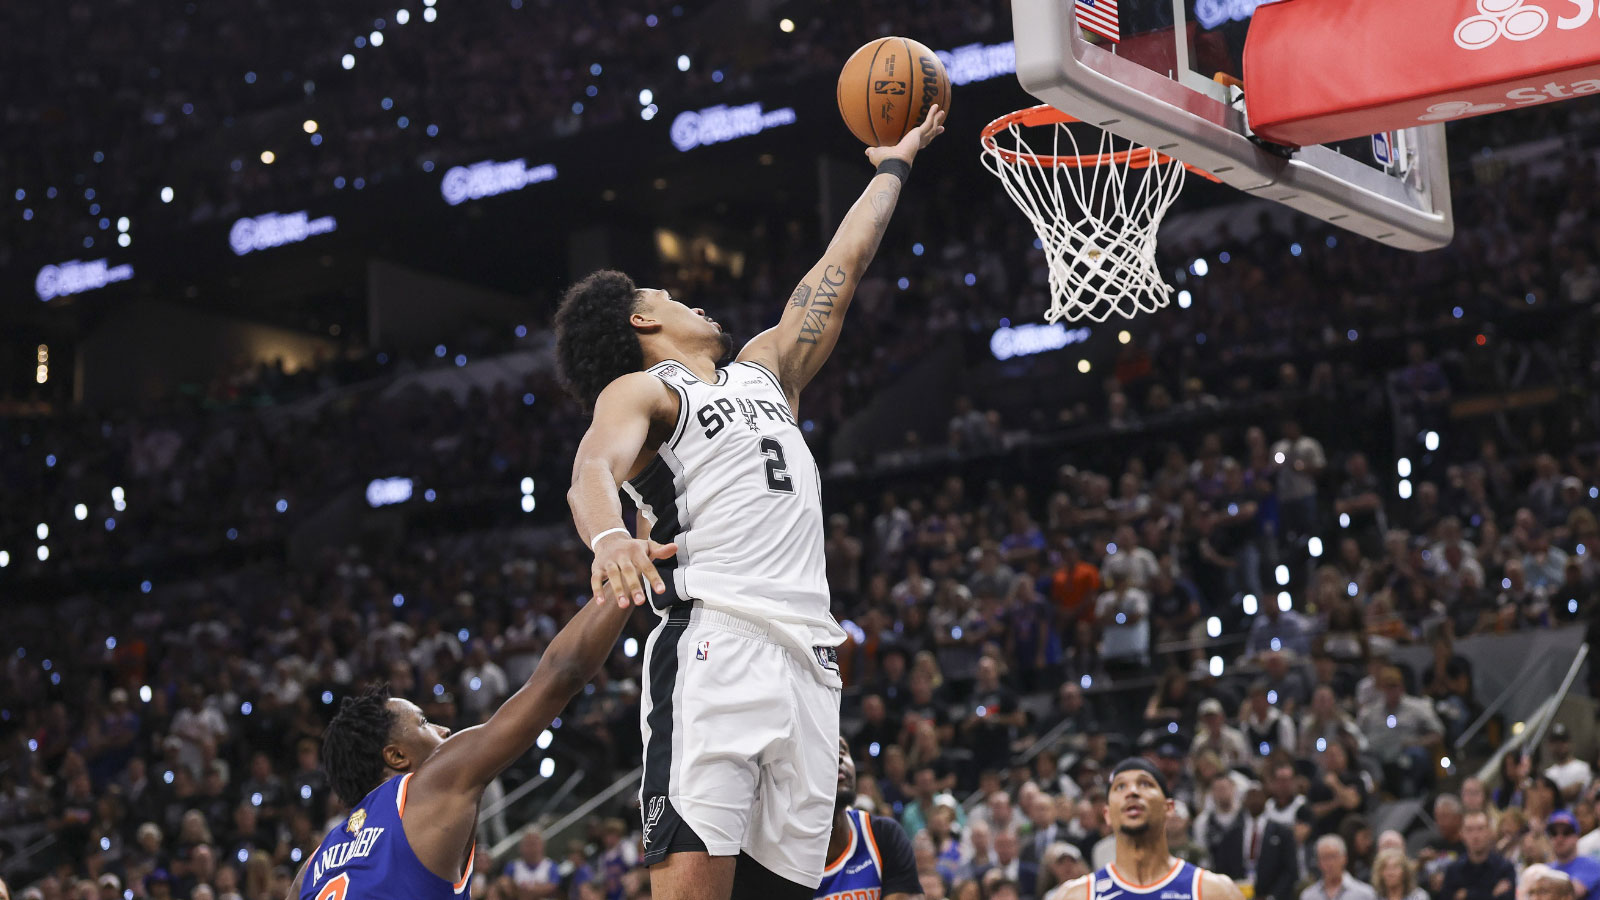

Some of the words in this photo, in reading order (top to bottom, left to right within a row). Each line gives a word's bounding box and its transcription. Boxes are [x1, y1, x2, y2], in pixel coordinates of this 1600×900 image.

[914, 56, 938, 126] Wilso
[796, 264, 847, 345] WAWG
[759, 435, 797, 495] 2
